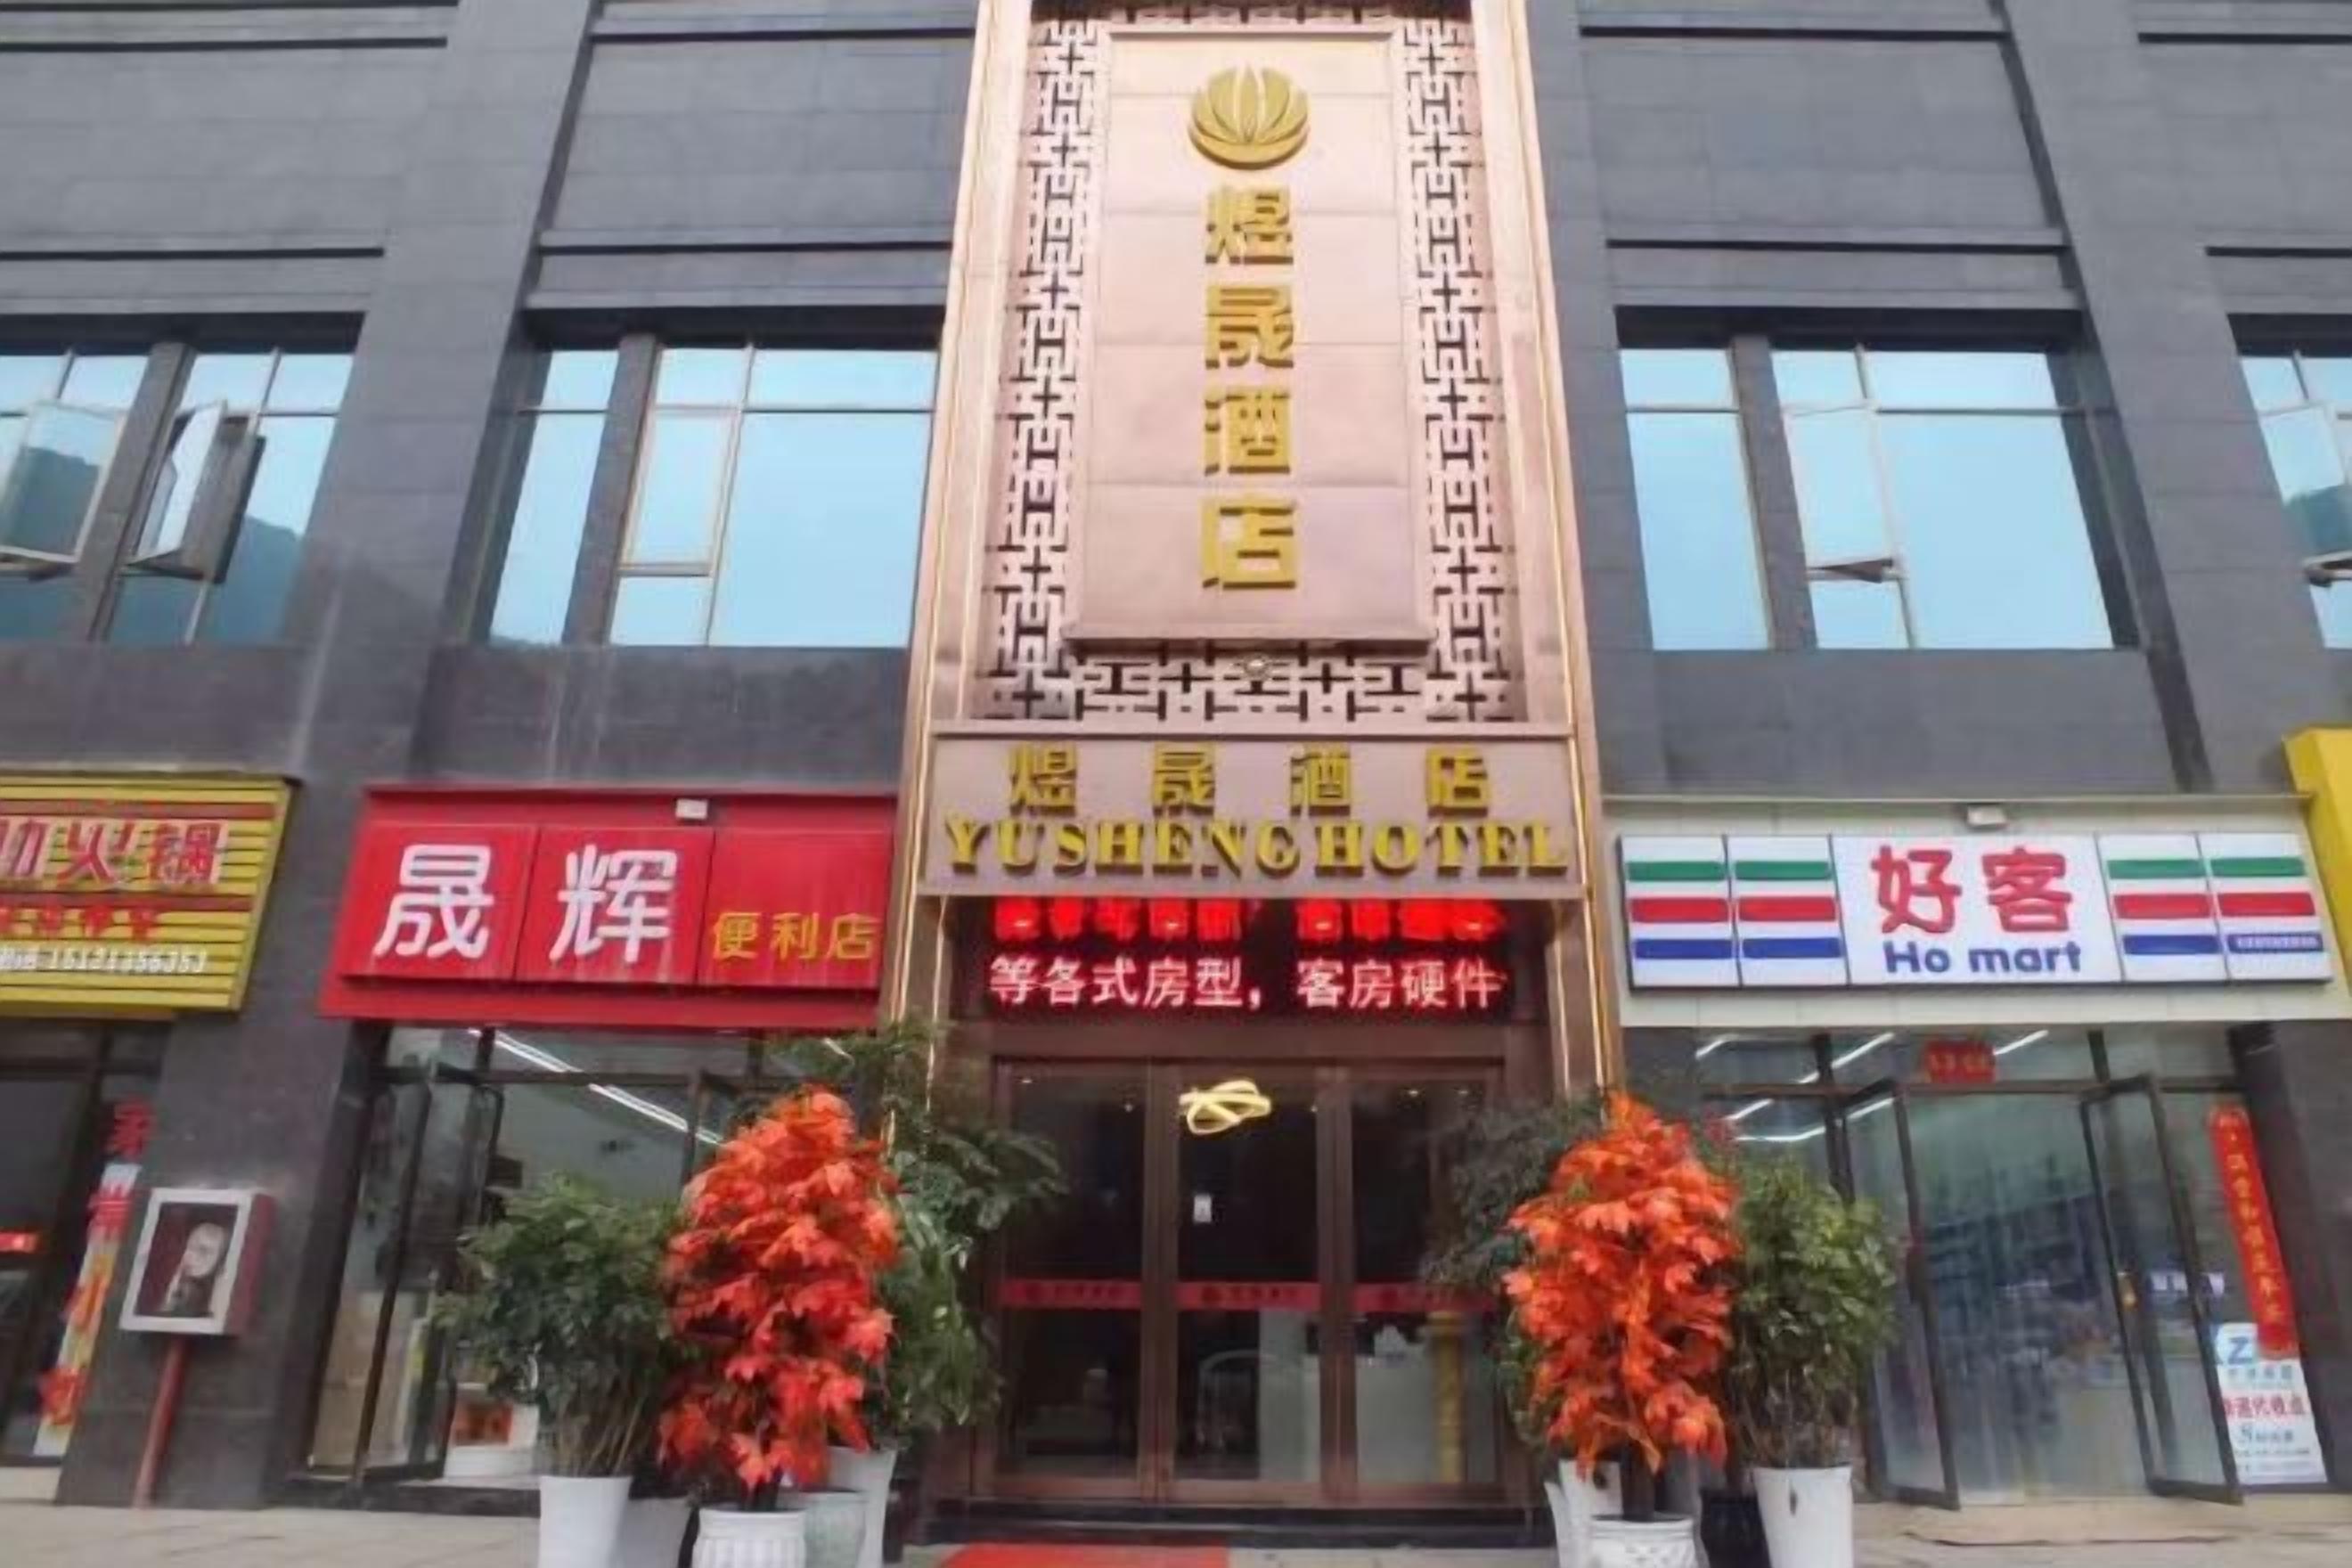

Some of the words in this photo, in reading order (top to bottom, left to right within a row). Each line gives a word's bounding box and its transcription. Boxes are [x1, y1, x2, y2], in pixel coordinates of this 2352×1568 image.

[1203, 185, 1296, 590] 煜晟酒店
[1009, 744, 1491, 816] 煜晟酒店
[944, 818, 1301, 877] YUSHENG
[1313, 820, 1570, 877] HOTEL
[372, 843, 679, 964] 晟辉
[1870, 845, 2072, 934] 好客
[713, 911, 882, 962] 便利店
[1884, 941, 1951, 975] Ho
[1969, 941, 2081, 975] mart
